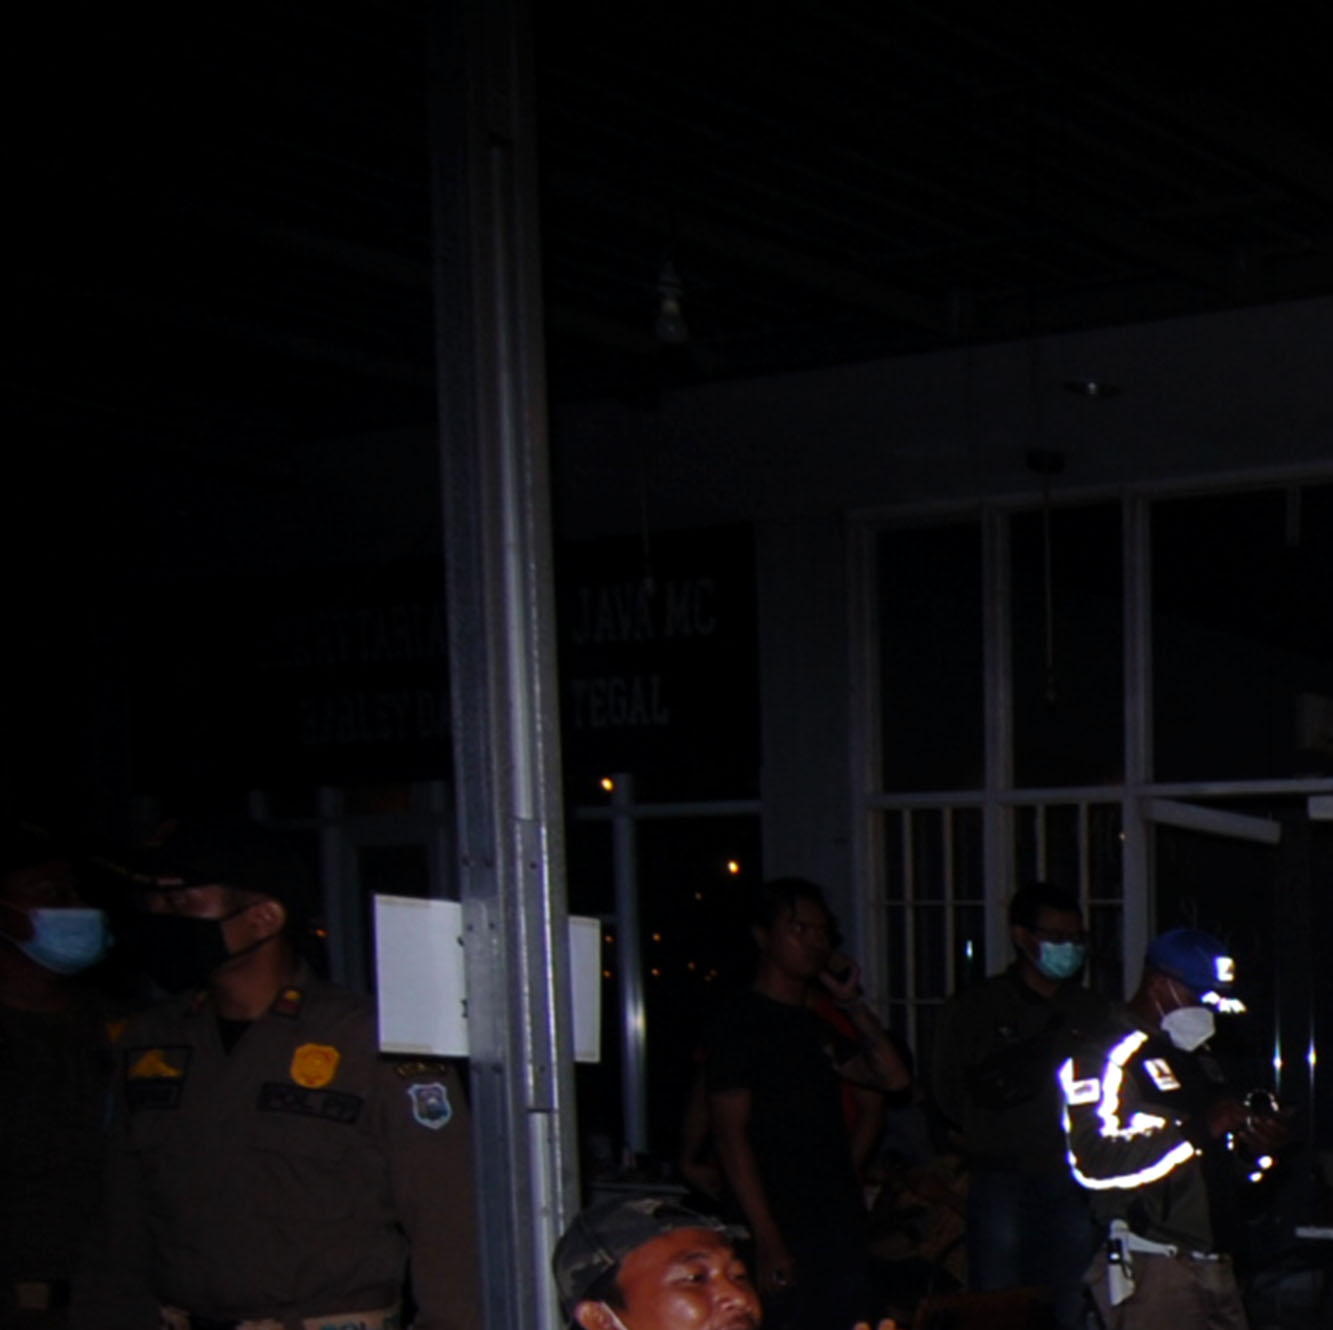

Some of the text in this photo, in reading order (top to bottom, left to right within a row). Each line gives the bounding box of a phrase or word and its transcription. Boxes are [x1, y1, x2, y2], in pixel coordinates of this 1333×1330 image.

[569, 582, 655, 646] JAVA
[662, 576, 719, 638] MC
[569, 674, 671, 729] TEGAL
